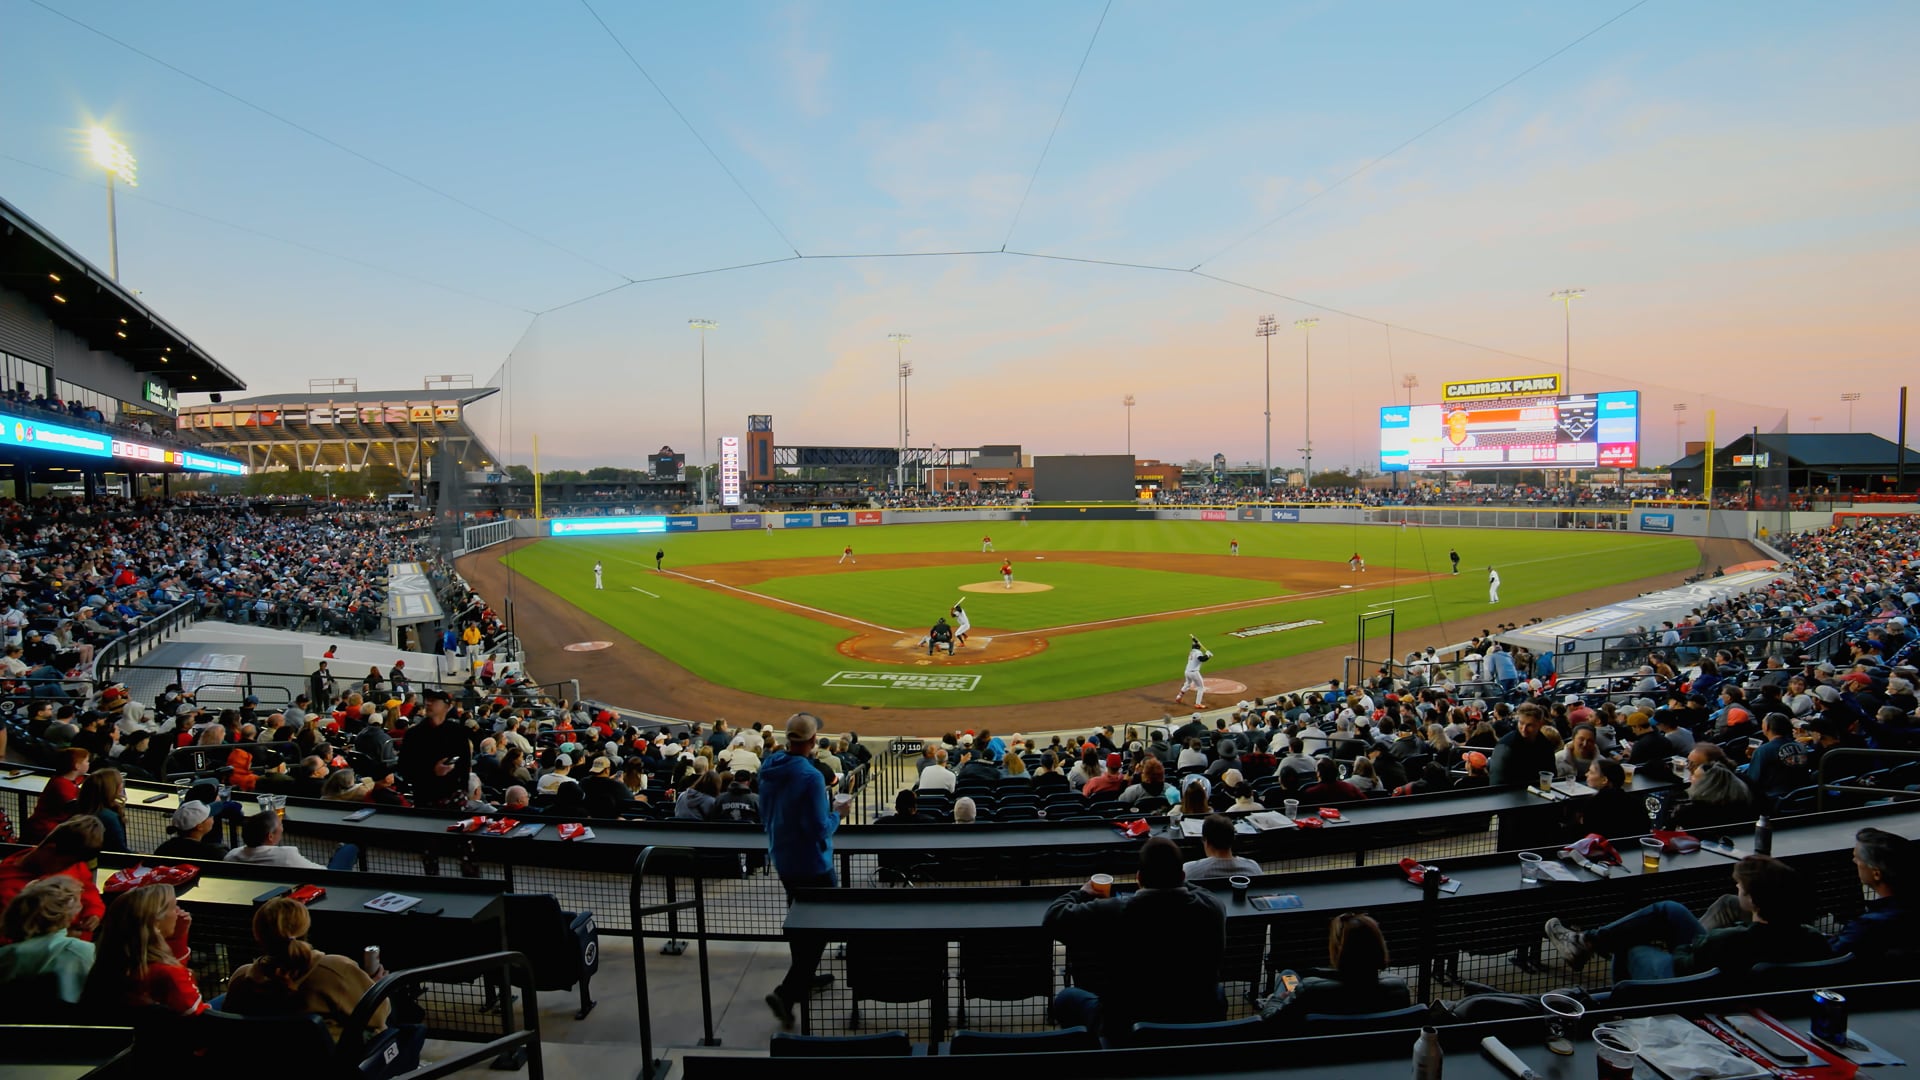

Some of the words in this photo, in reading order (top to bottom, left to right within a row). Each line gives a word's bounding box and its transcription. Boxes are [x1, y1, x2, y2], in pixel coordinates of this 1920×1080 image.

[1514, 377, 1555, 391] PARK
[892, 680, 967, 689] PARK
[386, 1047, 396, 1060] R
